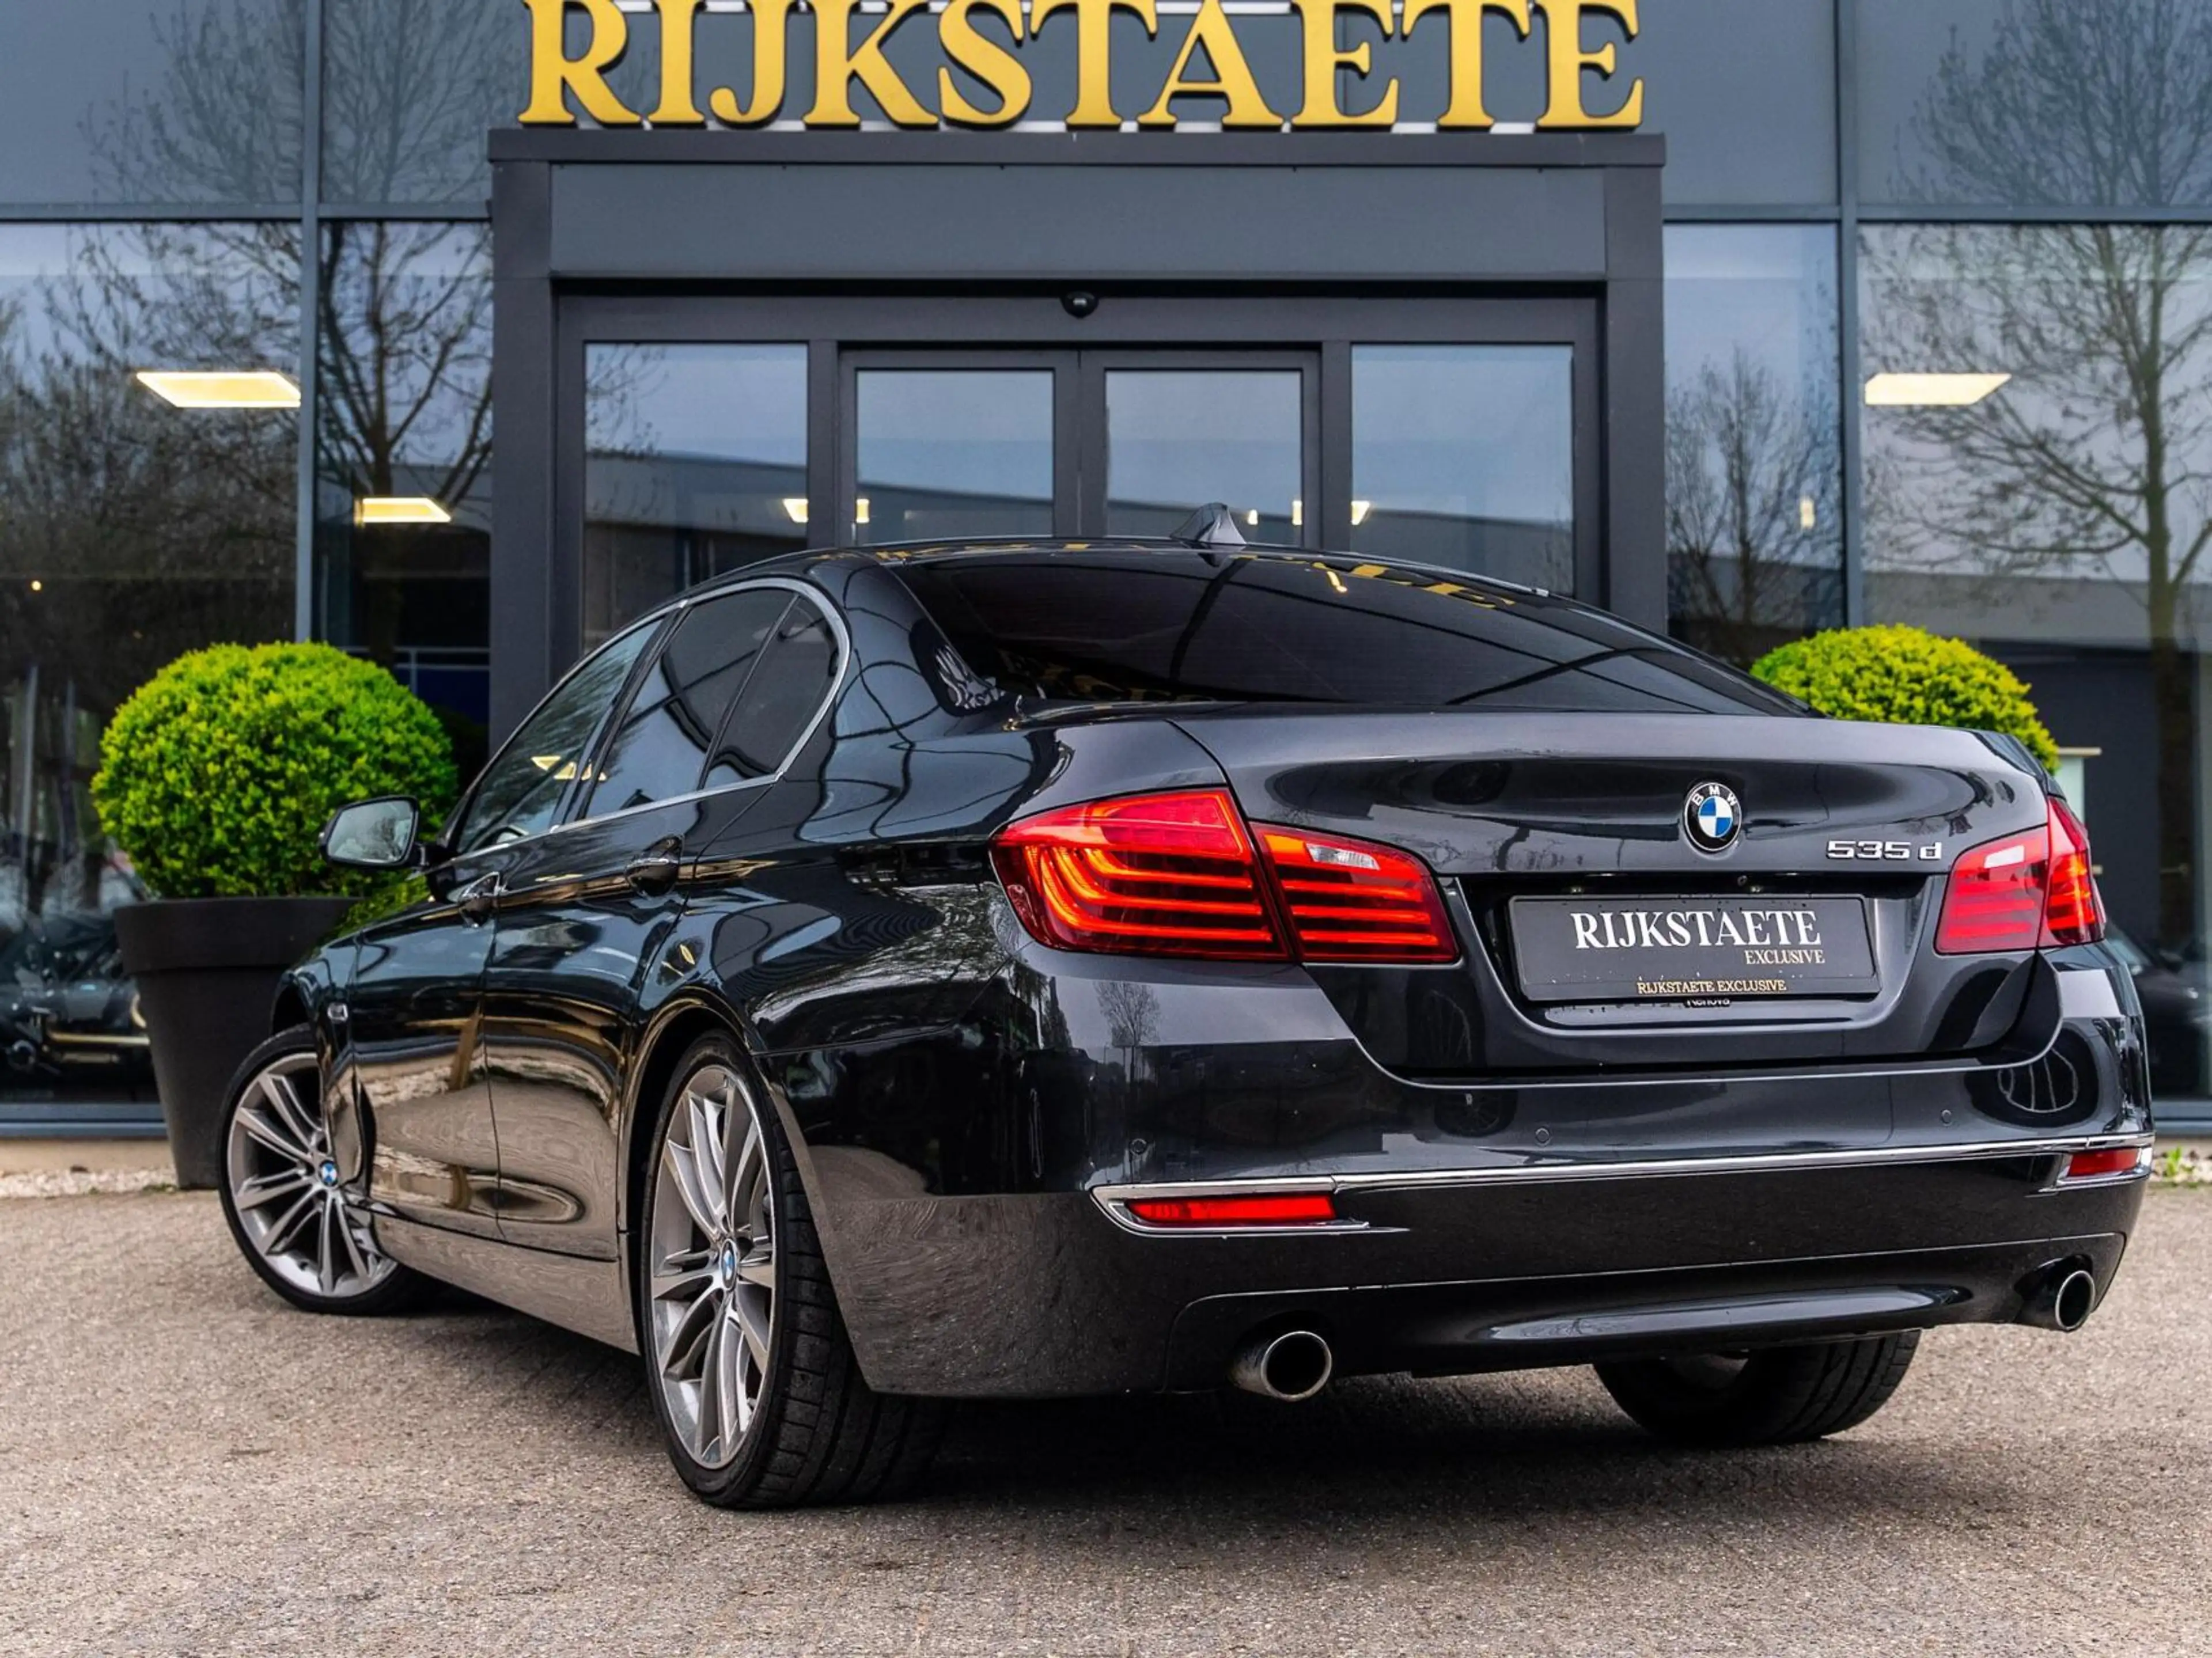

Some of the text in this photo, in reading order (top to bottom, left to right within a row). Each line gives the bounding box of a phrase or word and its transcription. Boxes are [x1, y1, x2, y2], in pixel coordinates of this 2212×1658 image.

[518, 0, 1644, 128] RIJKSTAETE
[1691, 785, 1738, 806] BMW
[1827, 840, 1911, 859] 535
[1570, 911, 1821, 949] RIJKSTAETE
[1744, 949, 1825, 965] EXCLUSIVE
[1637, 980, 1786, 994] RIJKSTAETE EXCLUSIVE
